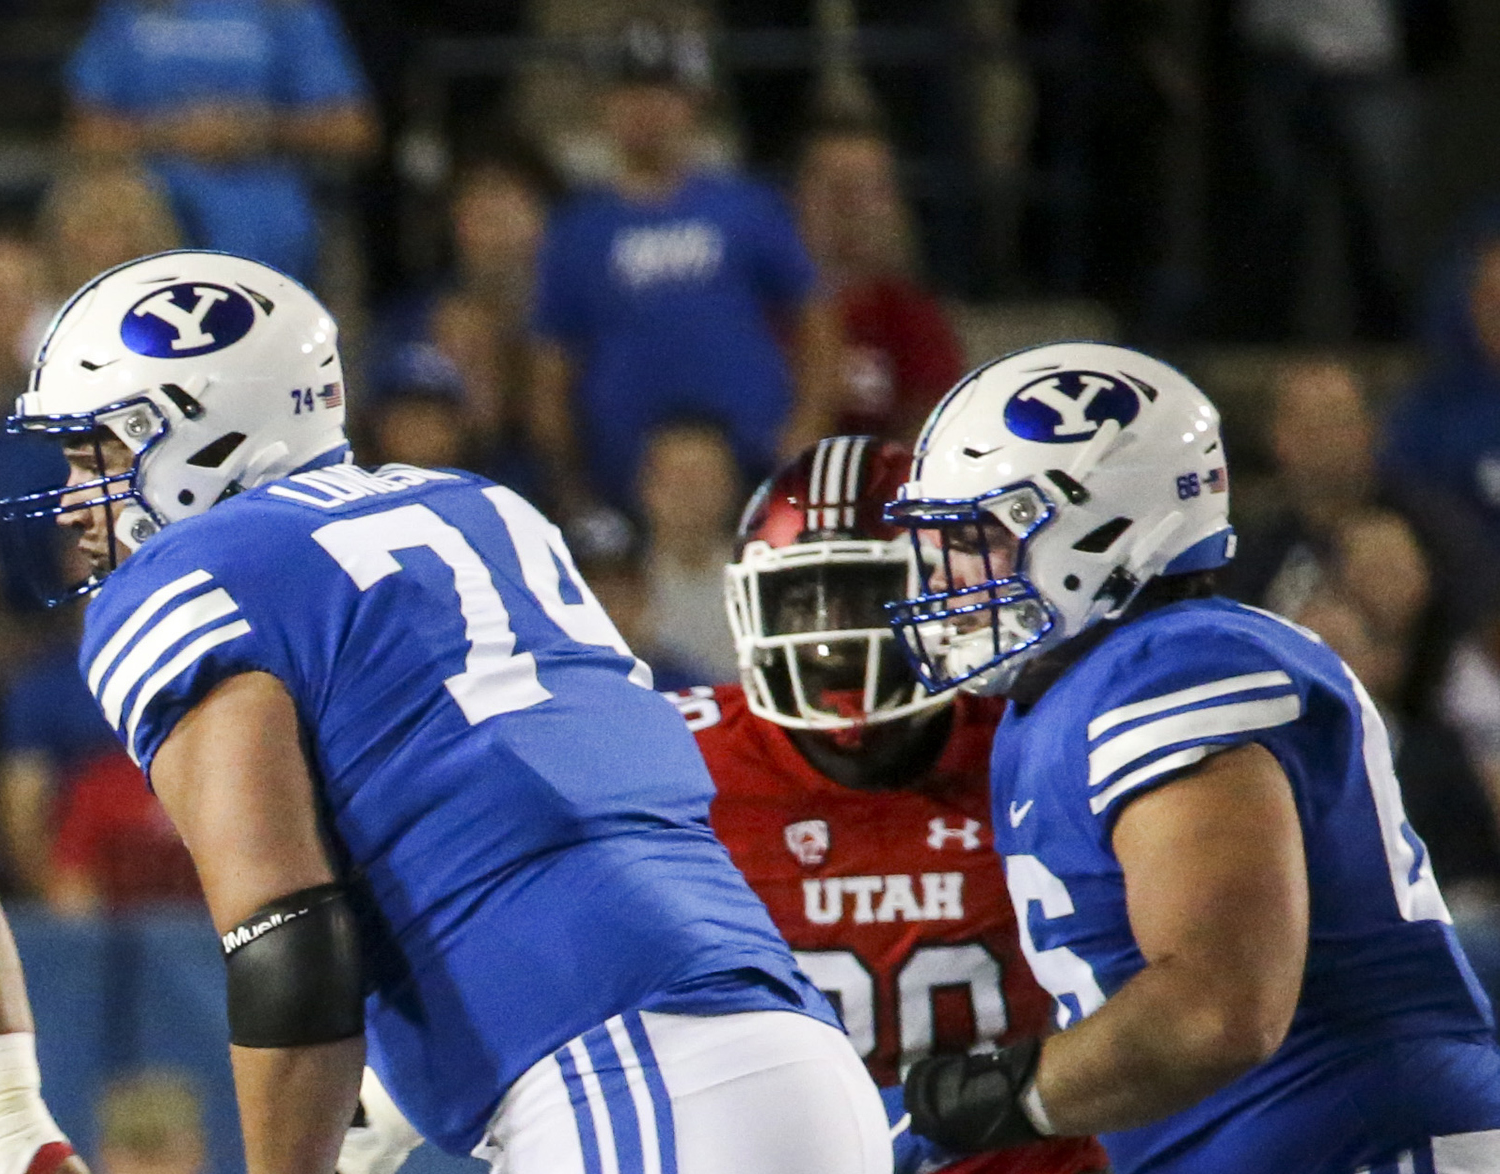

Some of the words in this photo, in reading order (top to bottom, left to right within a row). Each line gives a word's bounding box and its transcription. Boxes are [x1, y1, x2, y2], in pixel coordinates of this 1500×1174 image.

[133, 286, 229, 350] Y
[290, 387, 314, 414] 74
[1017, 375, 1115, 436] Y
[1177, 472, 1200, 500] 66
[312, 485, 653, 727] 74
[802, 872, 964, 925] UTAH
